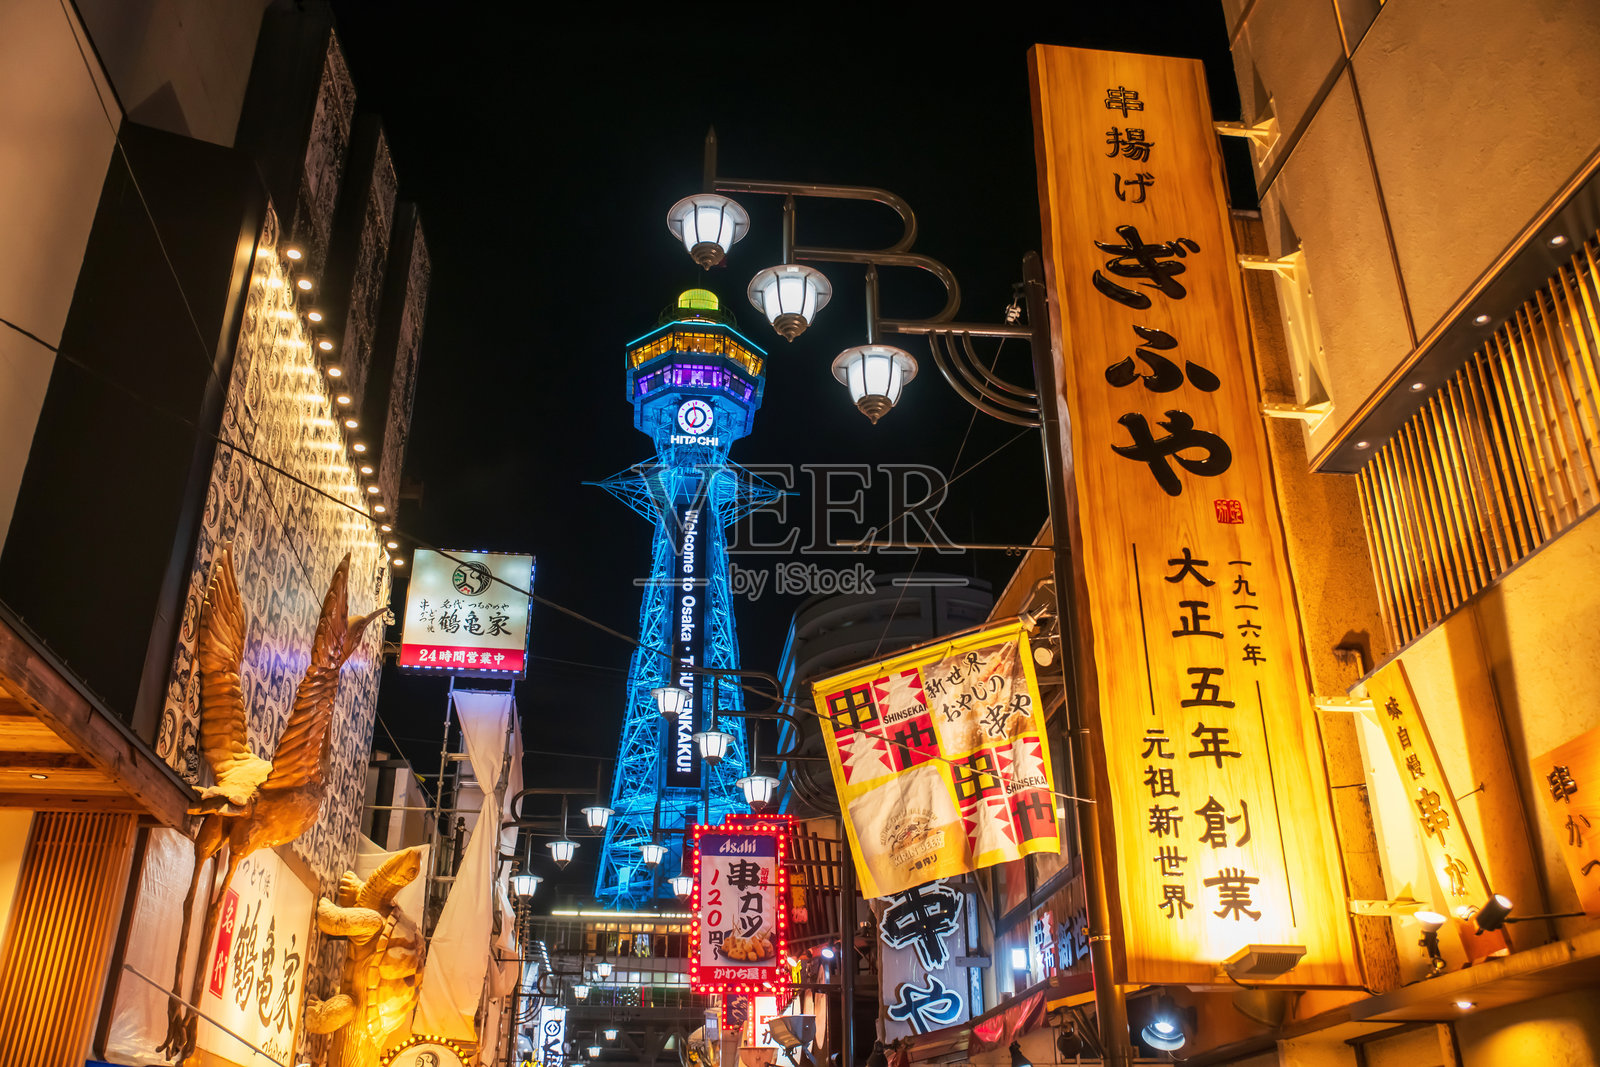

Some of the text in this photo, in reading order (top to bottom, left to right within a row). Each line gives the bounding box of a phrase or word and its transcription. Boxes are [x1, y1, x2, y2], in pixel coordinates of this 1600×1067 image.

[1104, 86, 1155, 204] 串揚げ
[1092, 225, 1233, 497] ぎふや
[670, 435, 719, 446] HITACHI
[683, 509, 699, 574] Welcome
[682, 576, 696, 592] to
[438, 608, 513, 637] 鶴亀家
[680, 595, 696, 642] Osaka
[1228, 560, 1267, 667] 一九一六年
[418, 648, 506, 665] 24時間営業中
[924, 651, 988, 699] 新世界
[828, 687, 878, 734] 串
[883, 703, 928, 725] SHINSEKAI
[942, 674, 1006, 723] おやじの
[1164, 547, 1262, 922] 大正五年創業
[1385, 696, 1426, 781] 味自慢
[953, 754, 1002, 802] 串
[1006, 775, 1048, 795] SHINSEKA
[719, 838, 757, 854] Asahi
[1141, 729, 1194, 921] 元祖新世界
[726, 859, 763, 938] 串カツ
[714, 967, 760, 980] かわち屋
